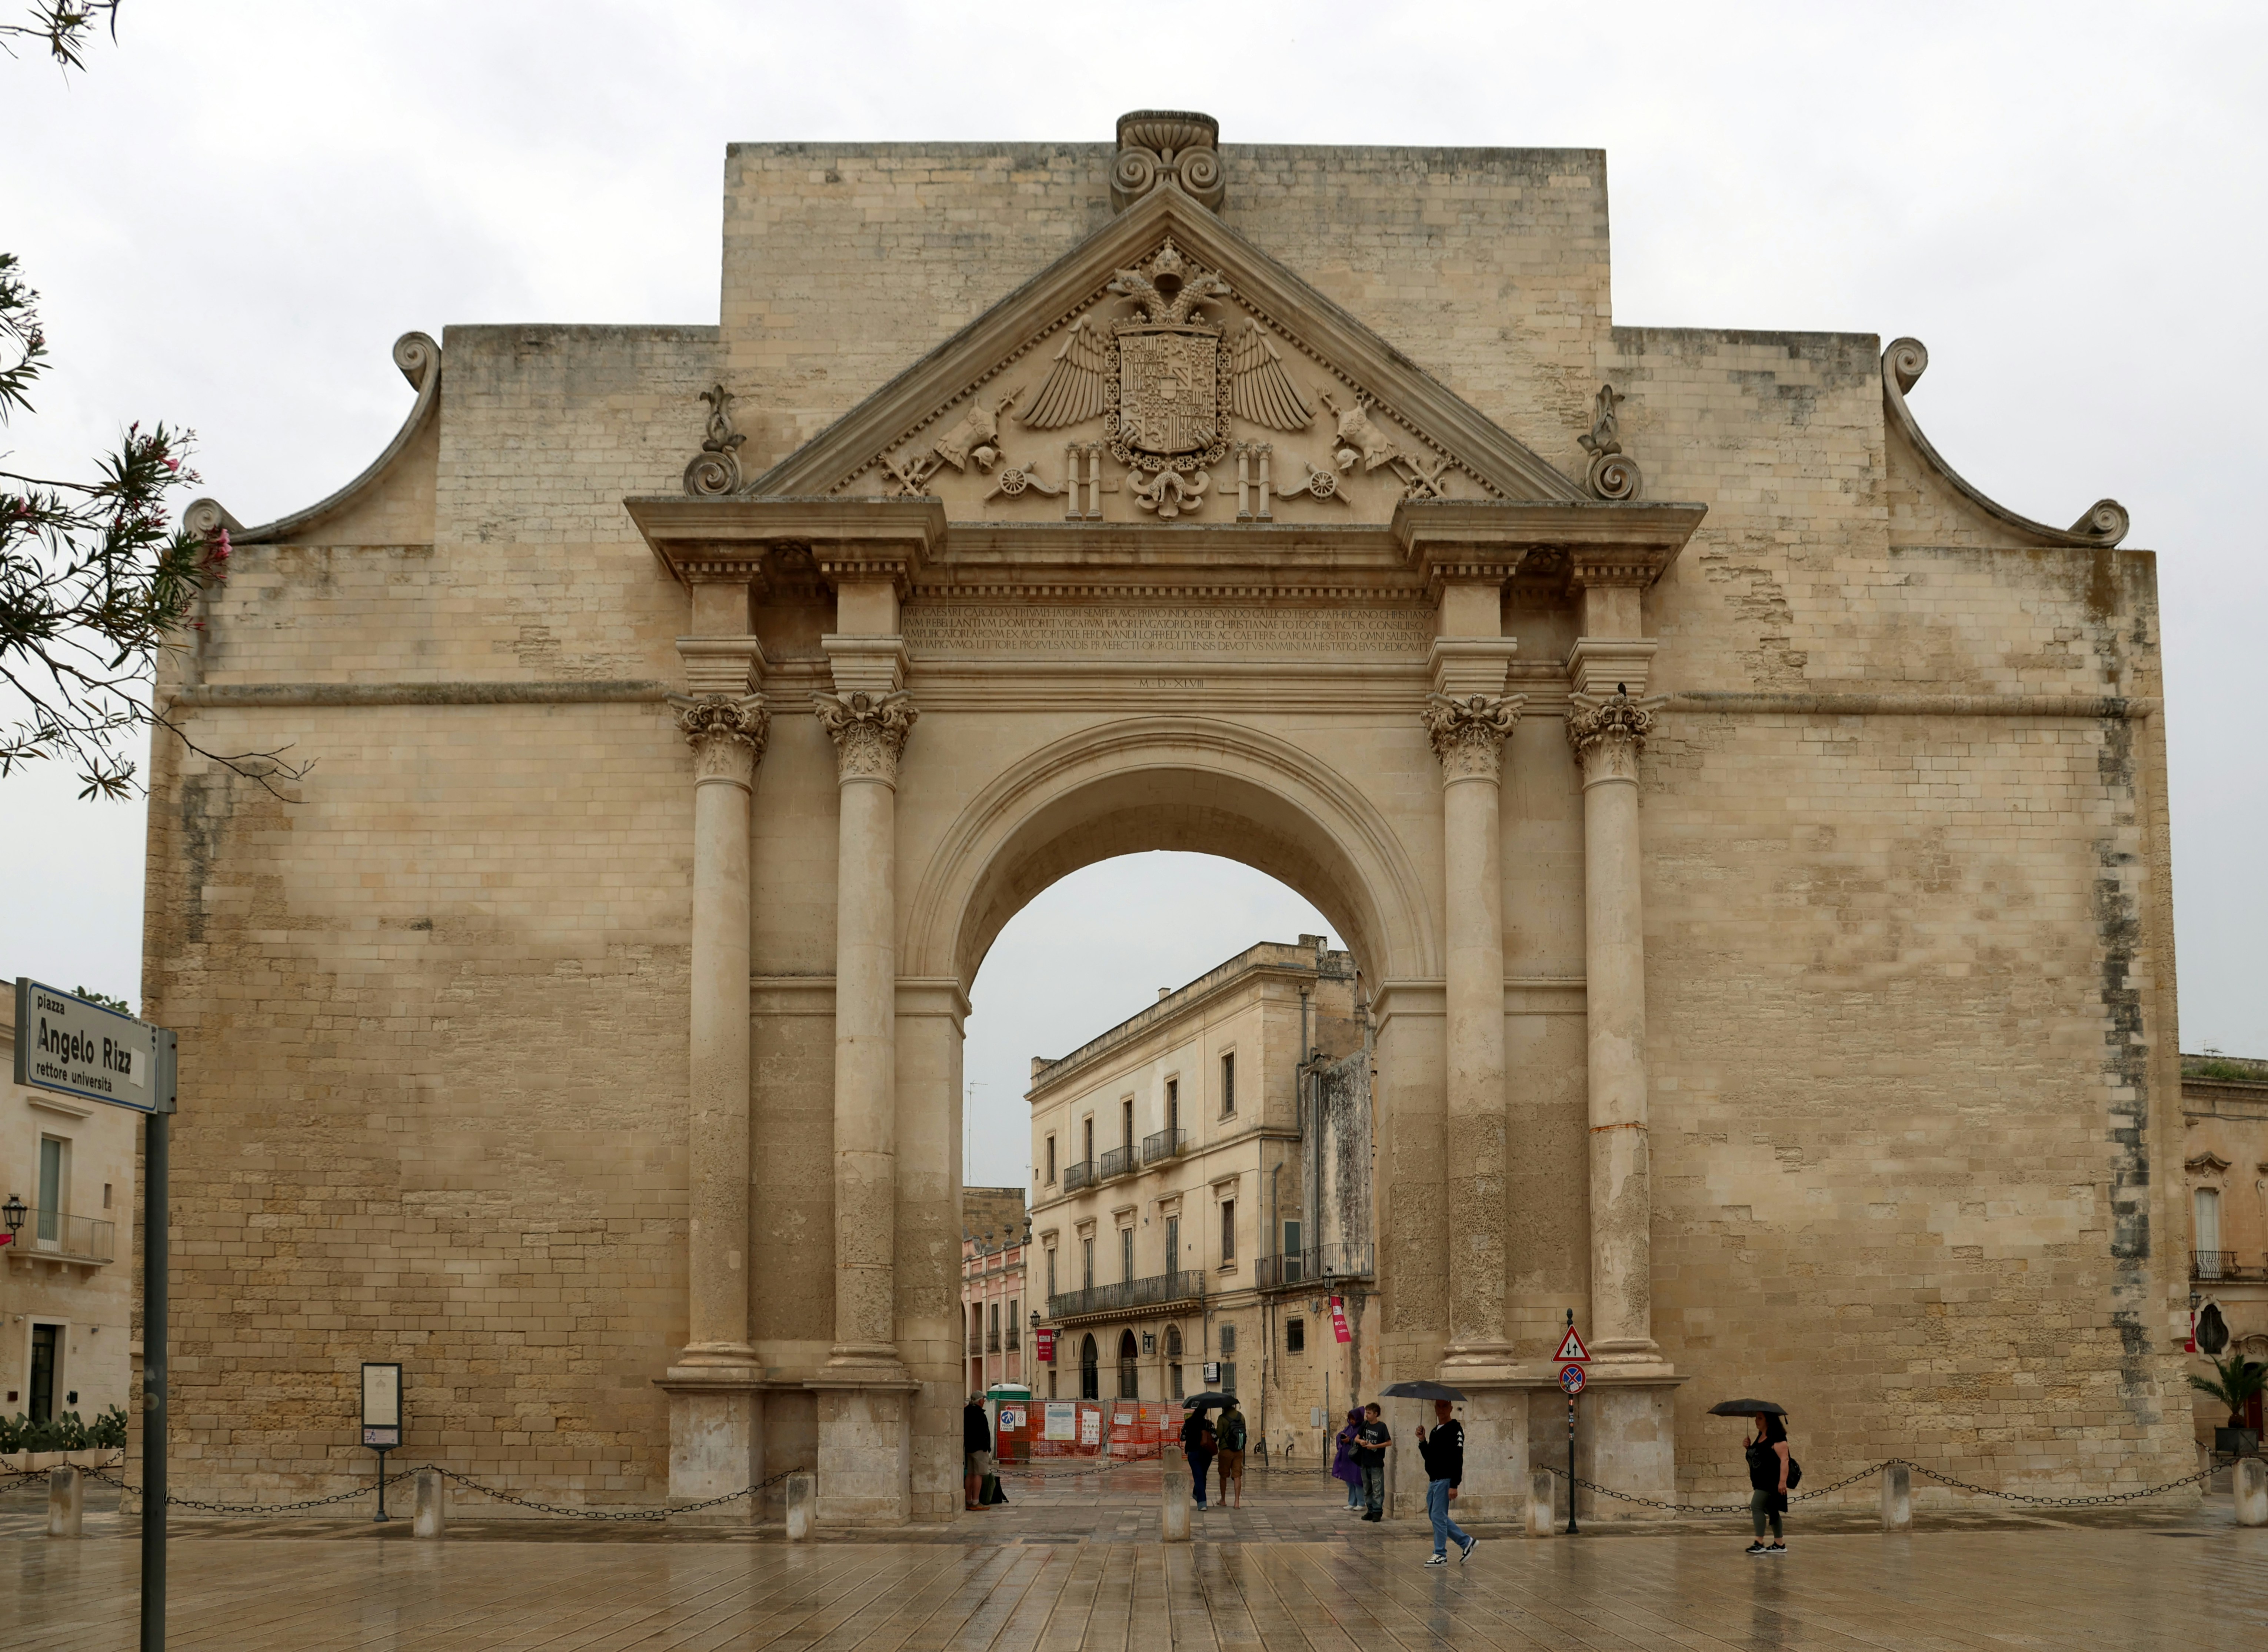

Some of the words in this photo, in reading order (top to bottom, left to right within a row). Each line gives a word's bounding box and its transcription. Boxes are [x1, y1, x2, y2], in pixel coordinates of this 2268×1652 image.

[922, 608, 960, 617] CAESARI
[1013, 608, 1081, 617] TRIVMPHATORI
[1084, 608, 1116, 618] SEMPER
[1138, 609, 1166, 618] PRIMO
[1205, 609, 1250, 618] SECVNDO
[1379, 610, 1433, 619] CHRISTIANO
[904, 618, 923, 627] RVM
[926, 618, 996, 628] REBELLANTIVM
[1050, 619, 1104, 628] TVRCARVM
[1215, 620, 1279, 629] CHRISTIANAE
[970, 629, 1005, 638] ARCVM
[1006, 630, 1019, 638] EX
[1020, 630, 1080, 638] AVCTORITATE
[1083, 630, 1136, 639] FERDINANDI
[1139, 630, 1180, 639] LOFFREDI
[1181, 630, 1216, 639] TVRCIS
[1217, 631, 1231, 640] AC
[1233, 631, 1276, 640] CAETERIS
[1278, 631, 1311, 640] CAROLI
[1314, 631, 1358, 640] HOSTIBVS
[1359, 631, 1384, 640] OMNI
[1386, 632, 1434, 641] SALENTINO
[976, 640, 1017, 649] LITTORE
[1020, 640, 1088, 650] PROPVLSANDIS
[1218, 641, 1264, 650] DEVOTVS
[1266, 642, 1300, 651] NVMINI
[1359, 642, 1376, 651] EIVS
[1378, 643, 1431, 651] DEDICAVIT
[37, 993, 65, 1015] piazza
[37, 1017, 94, 1064] Angelo
[103, 1037, 131, 1075] Rizz
[37, 1062, 67, 1081] rettore
